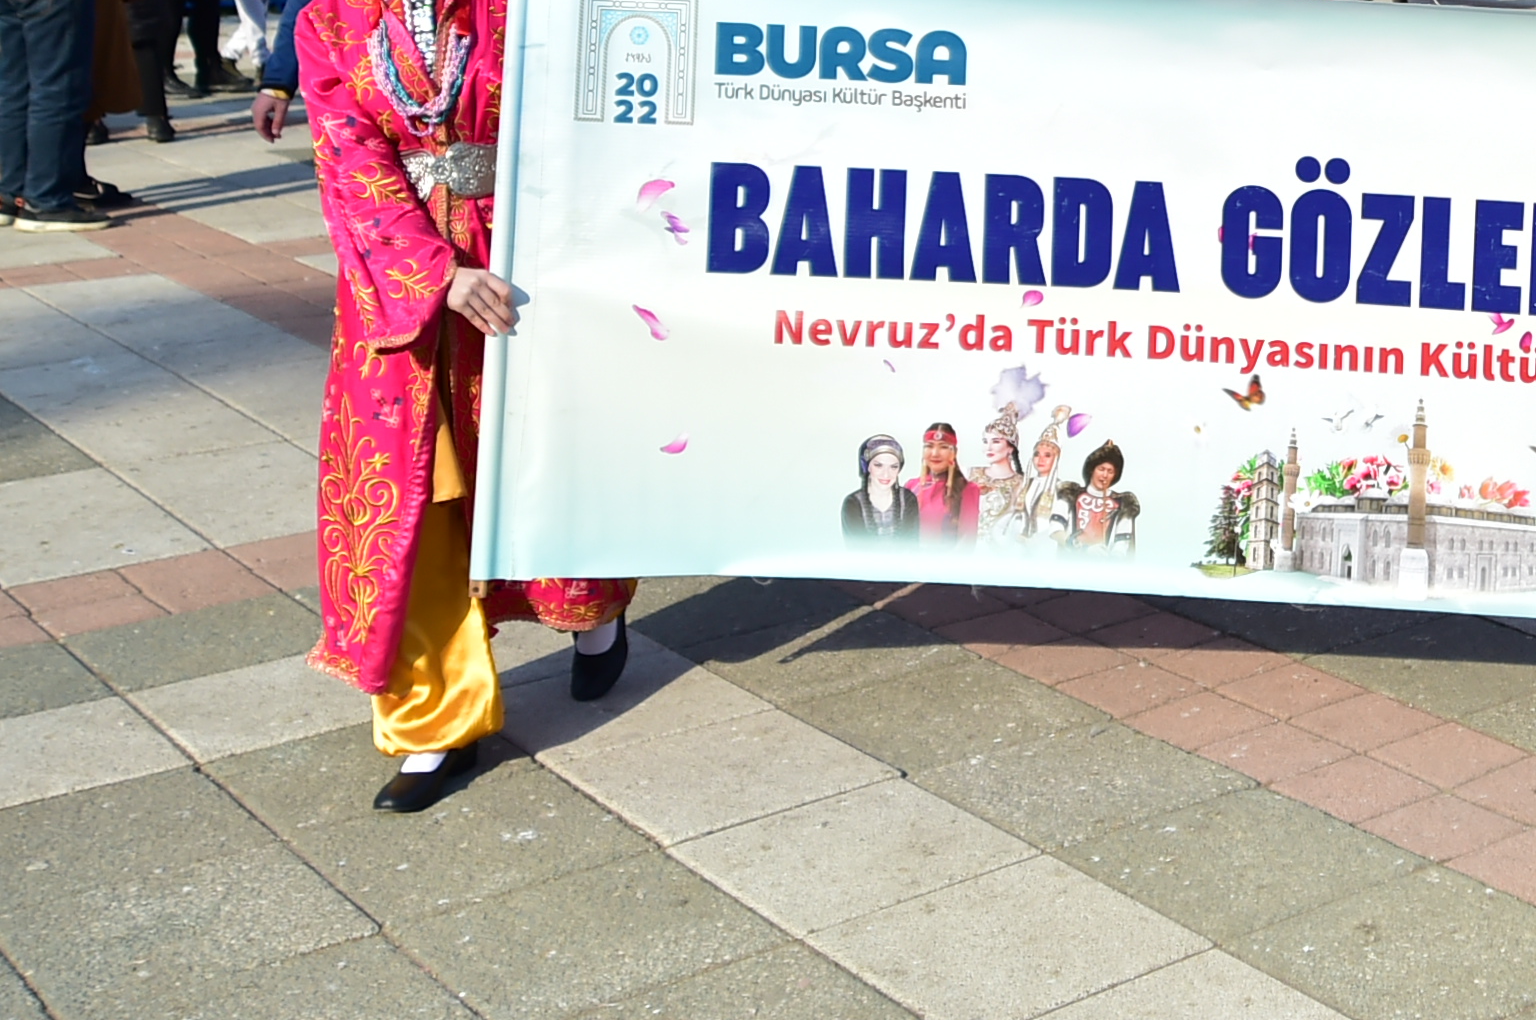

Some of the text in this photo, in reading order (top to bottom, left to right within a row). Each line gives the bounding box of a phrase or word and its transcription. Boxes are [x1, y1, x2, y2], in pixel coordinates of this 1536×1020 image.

[714, 22, 967, 86] BURSA
[614, 71, 659, 98] 20
[714, 82, 967, 112] Türk Dünyası Kültür Başkenti
[613, 99, 658, 125] 22
[706, 161, 1181, 293] BAHARDA
[773, 309, 1013, 353] Nevruz'da
[1027, 316, 1133, 359] Türk
[1147, 323, 1404, 376] Dünyasının
